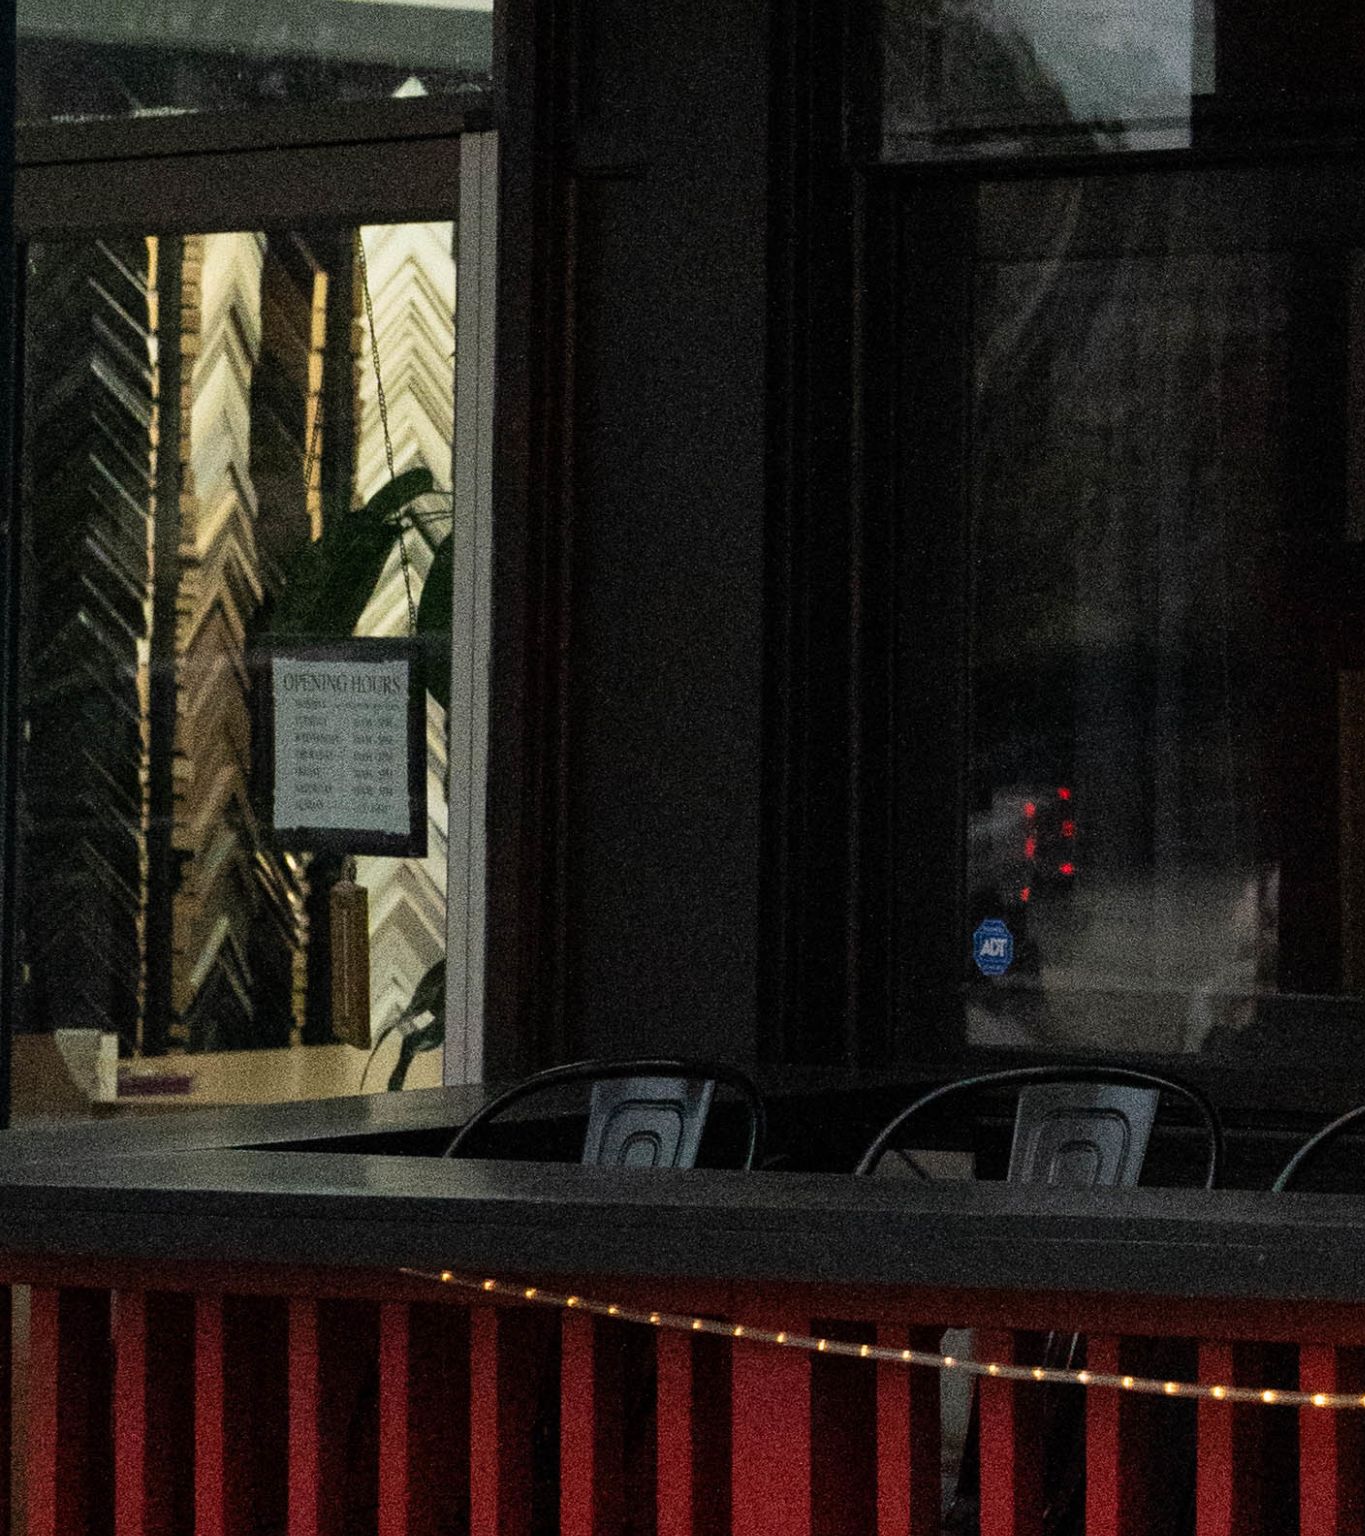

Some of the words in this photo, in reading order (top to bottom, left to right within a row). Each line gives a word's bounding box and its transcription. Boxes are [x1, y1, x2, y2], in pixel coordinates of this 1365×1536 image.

[284, 673, 348, 694] OPENING
[351, 674, 401, 695] HOURS
[980, 937, 1008, 957] ADT
